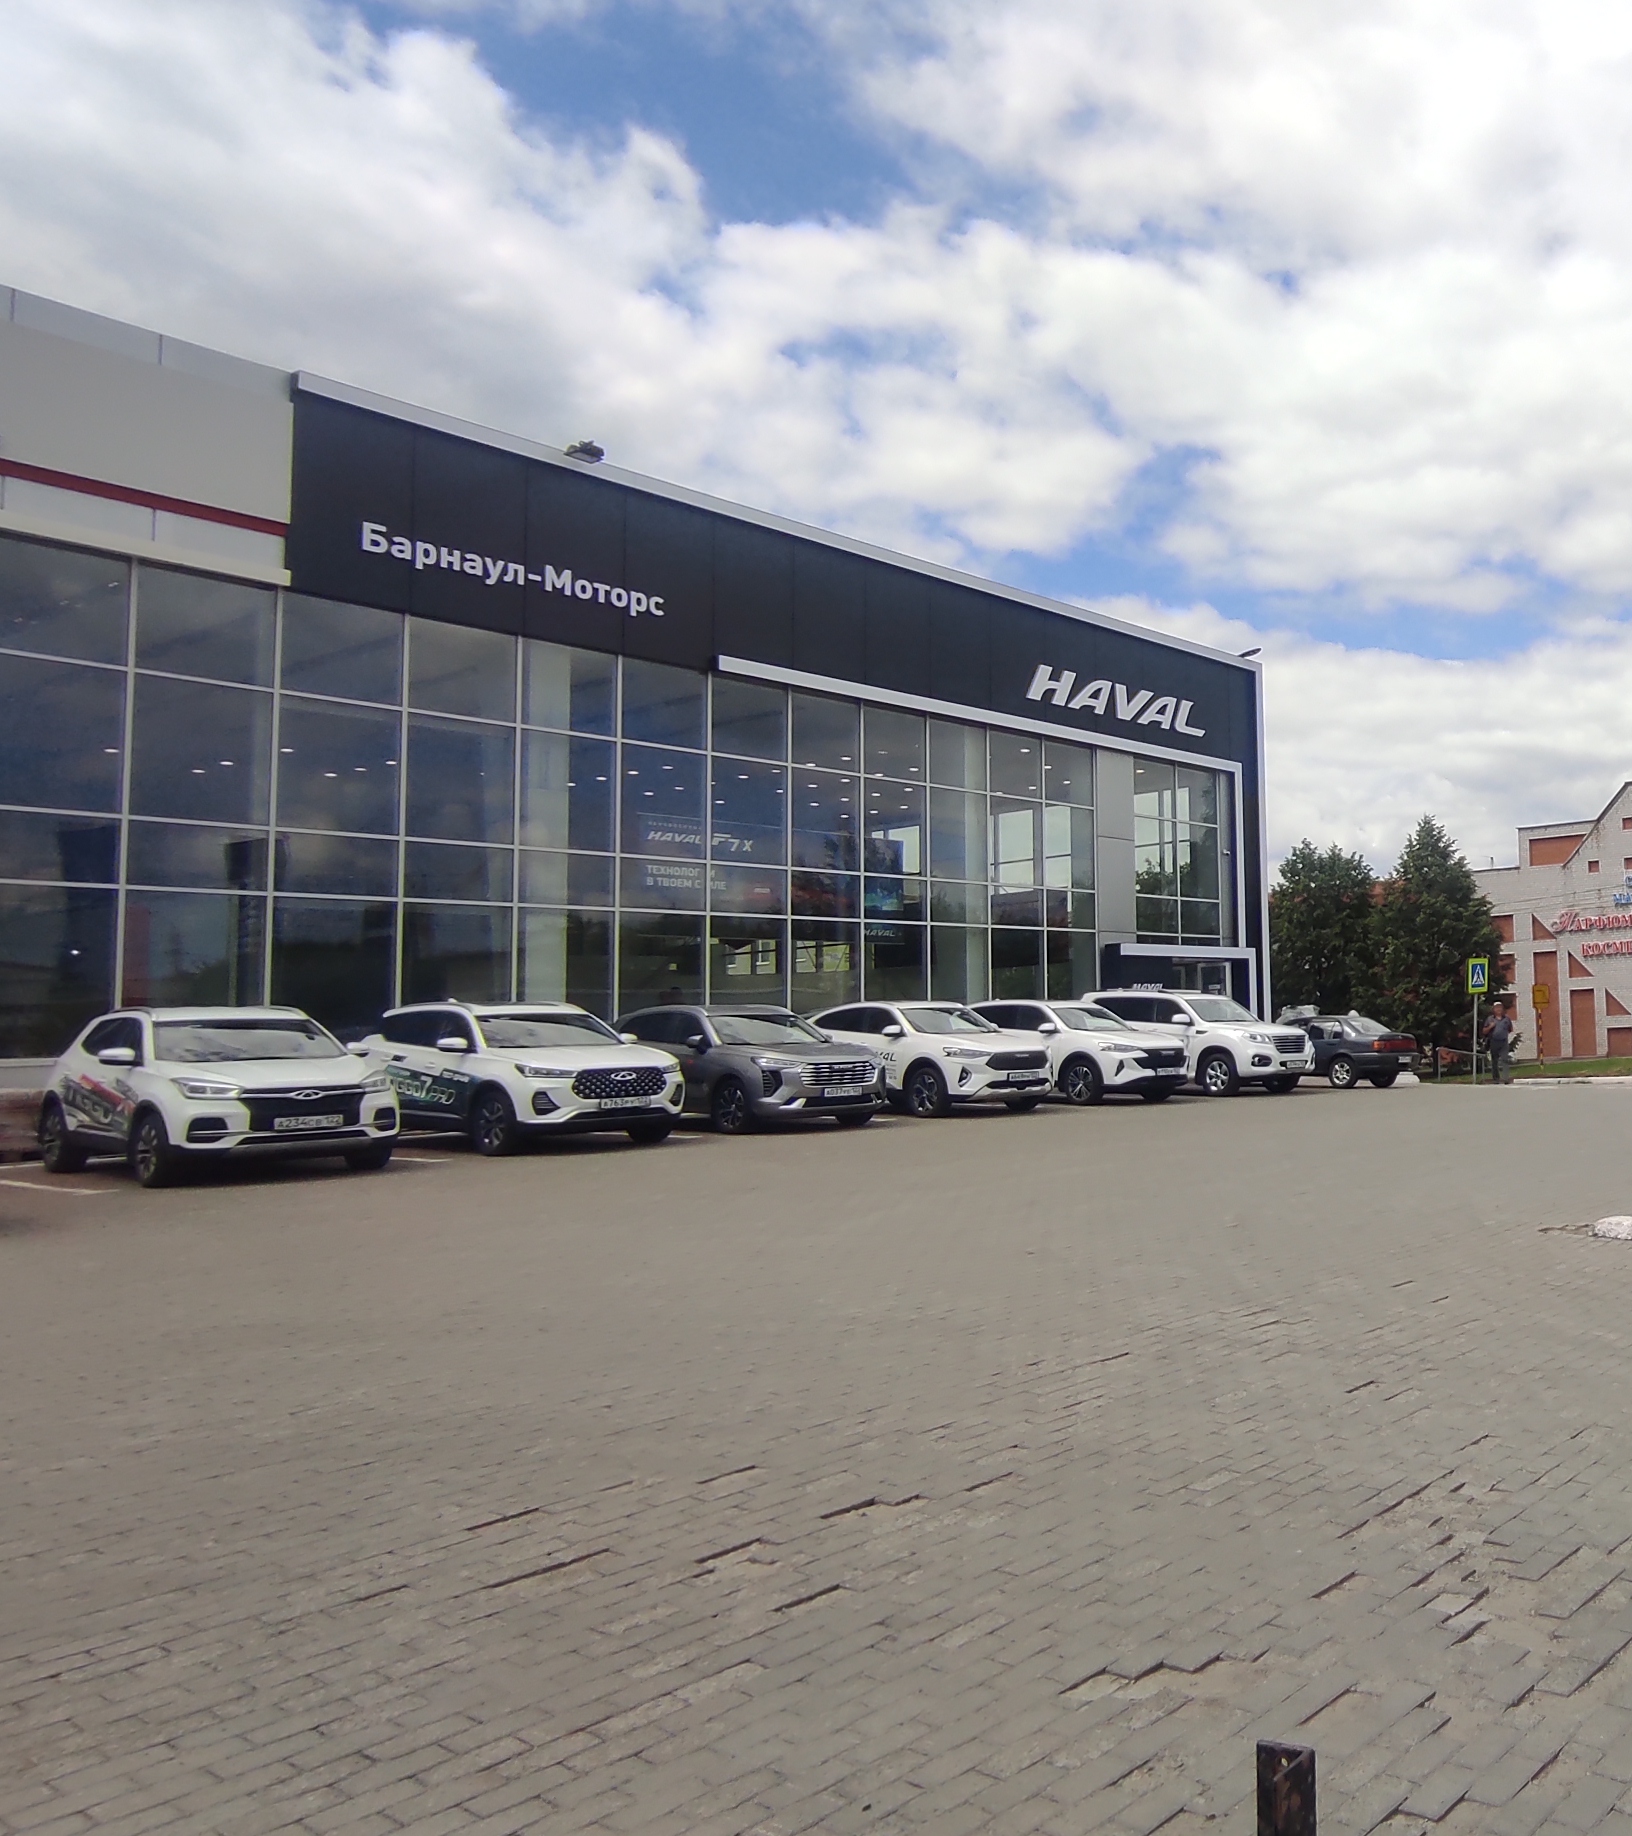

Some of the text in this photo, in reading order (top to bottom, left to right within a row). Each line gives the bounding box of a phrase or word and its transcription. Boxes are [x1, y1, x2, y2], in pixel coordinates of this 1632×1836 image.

[361, 521, 665, 617] Барнаул-Моторс
[1025, 663, 1206, 738] HAVAL
[647, 830, 702, 844] HAVAL
[656, 877, 692, 888] ТВОЕМ
